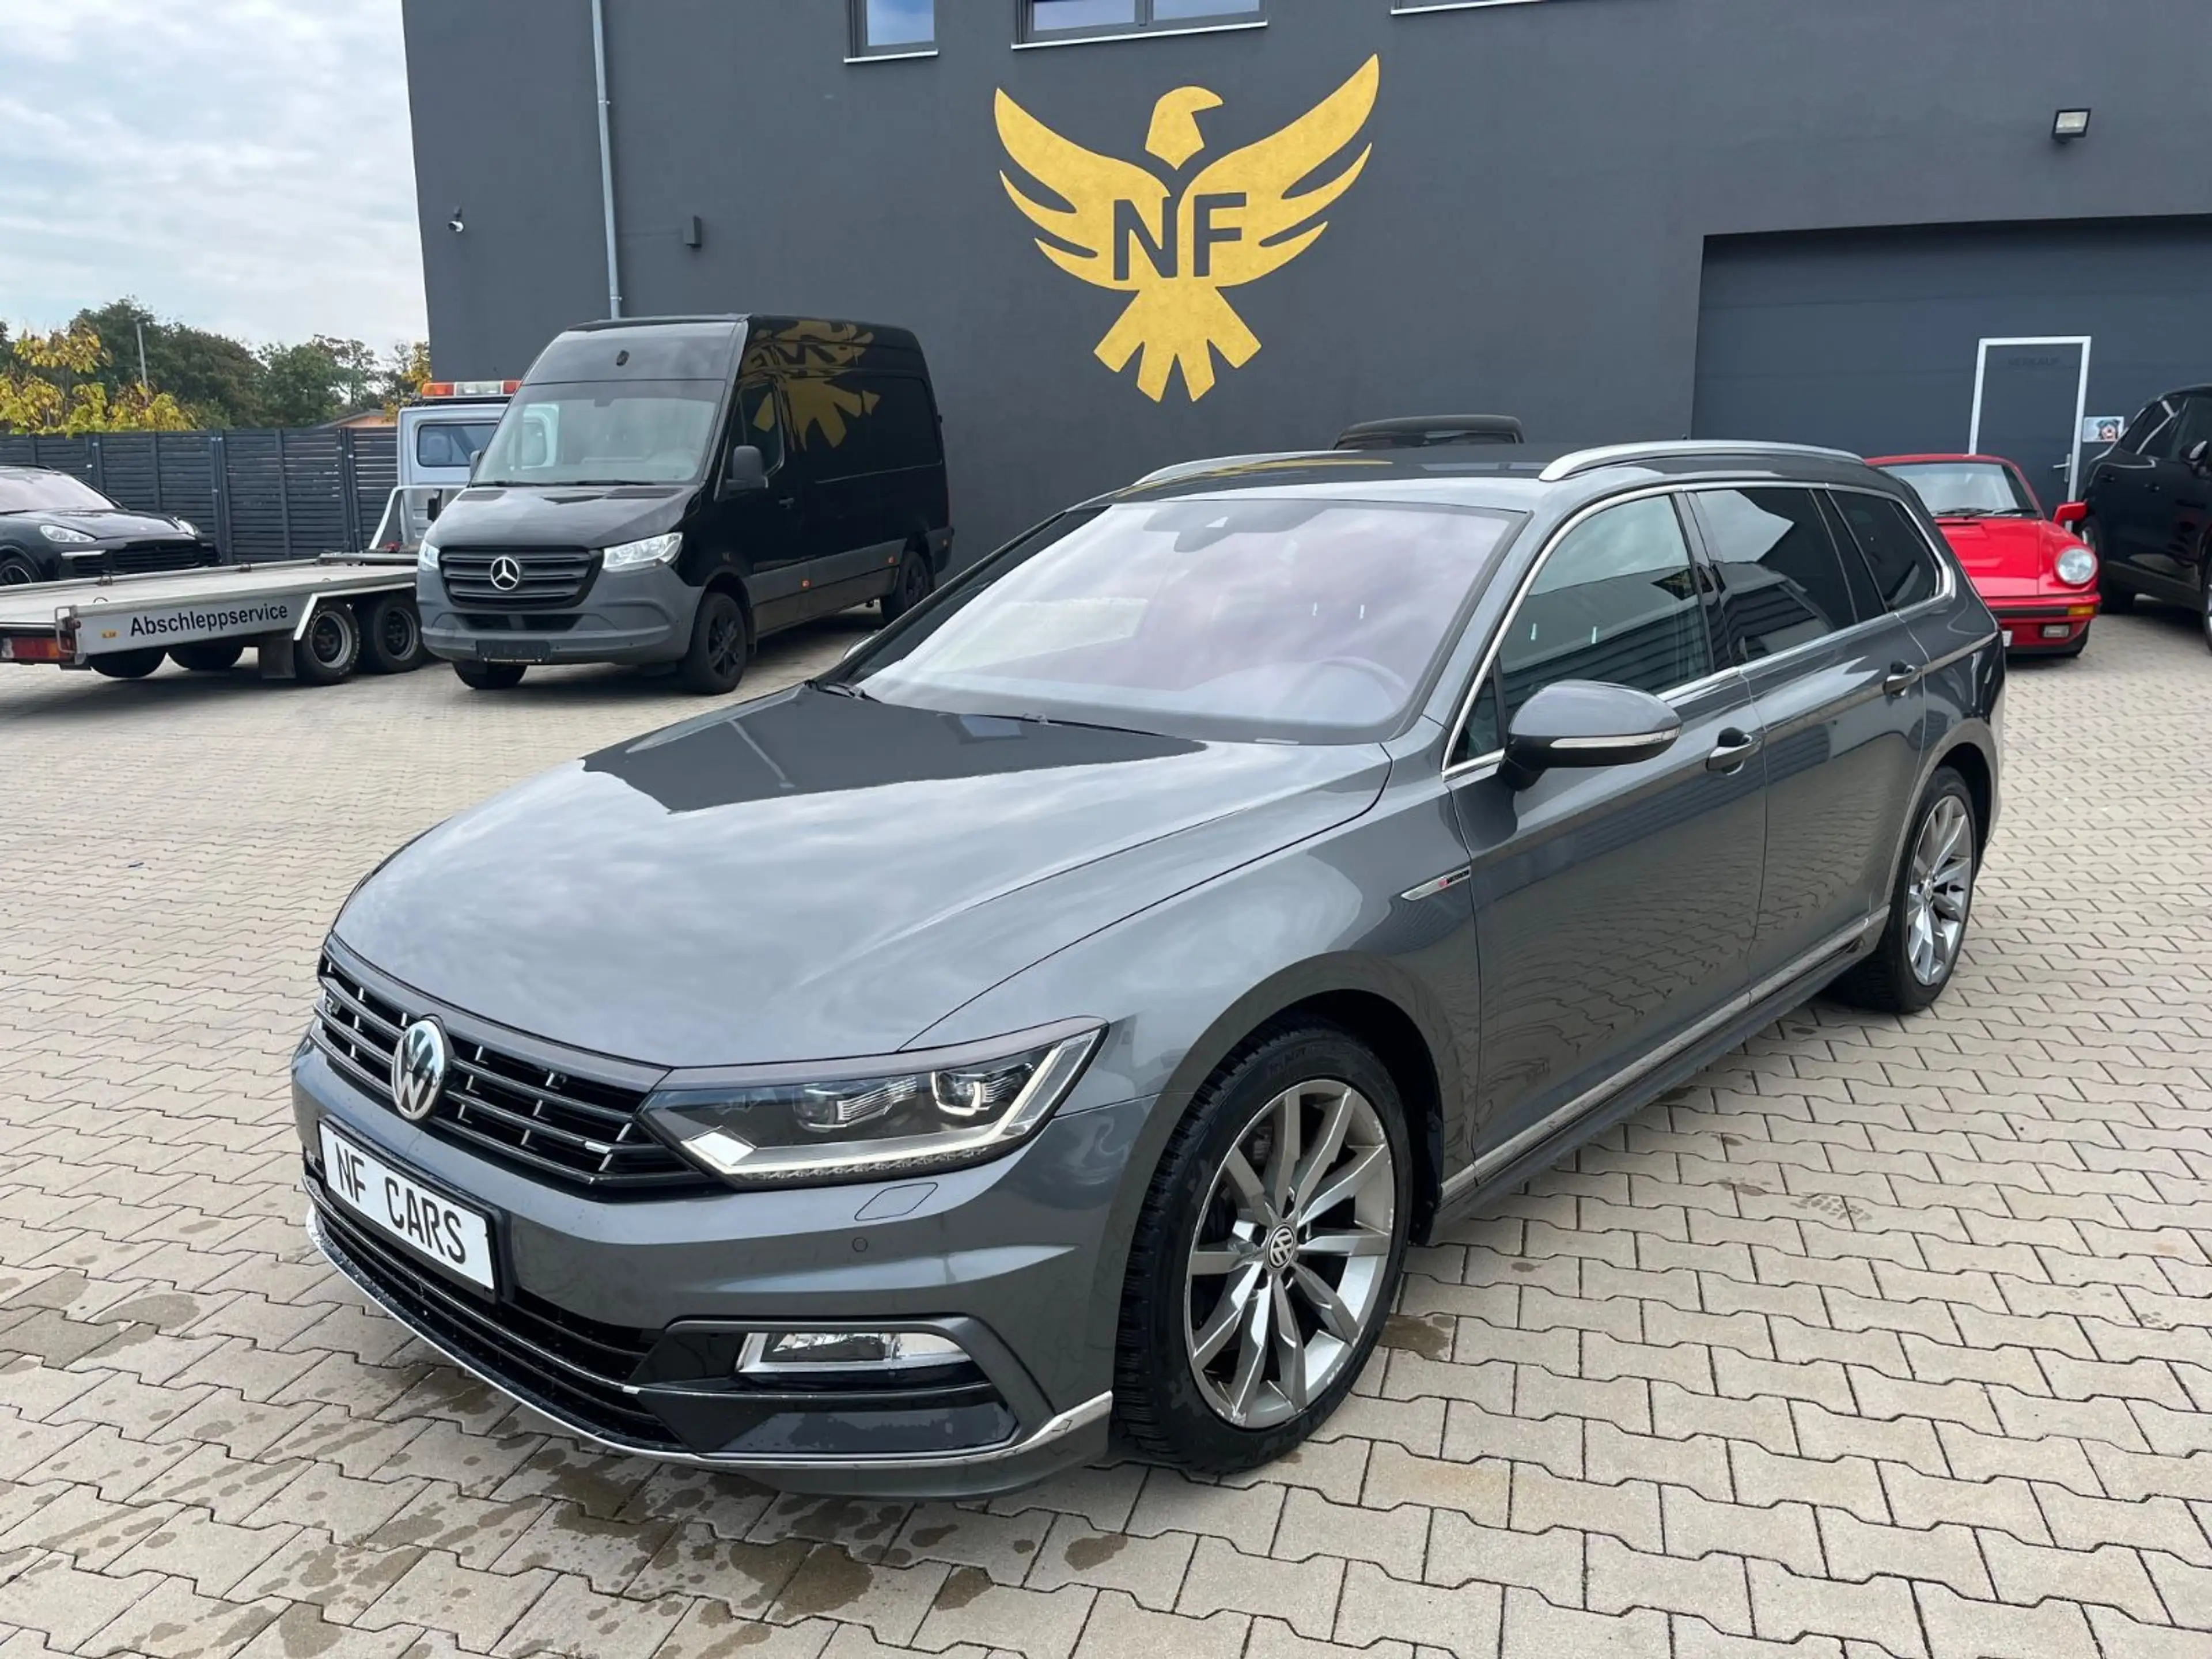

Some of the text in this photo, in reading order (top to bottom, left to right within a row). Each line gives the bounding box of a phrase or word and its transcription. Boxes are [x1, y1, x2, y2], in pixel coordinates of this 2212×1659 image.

[1113, 192, 1247, 281] NF
[130, 603, 288, 636] Abschleppservice
[336, 1142, 466, 1264] NF CARS
